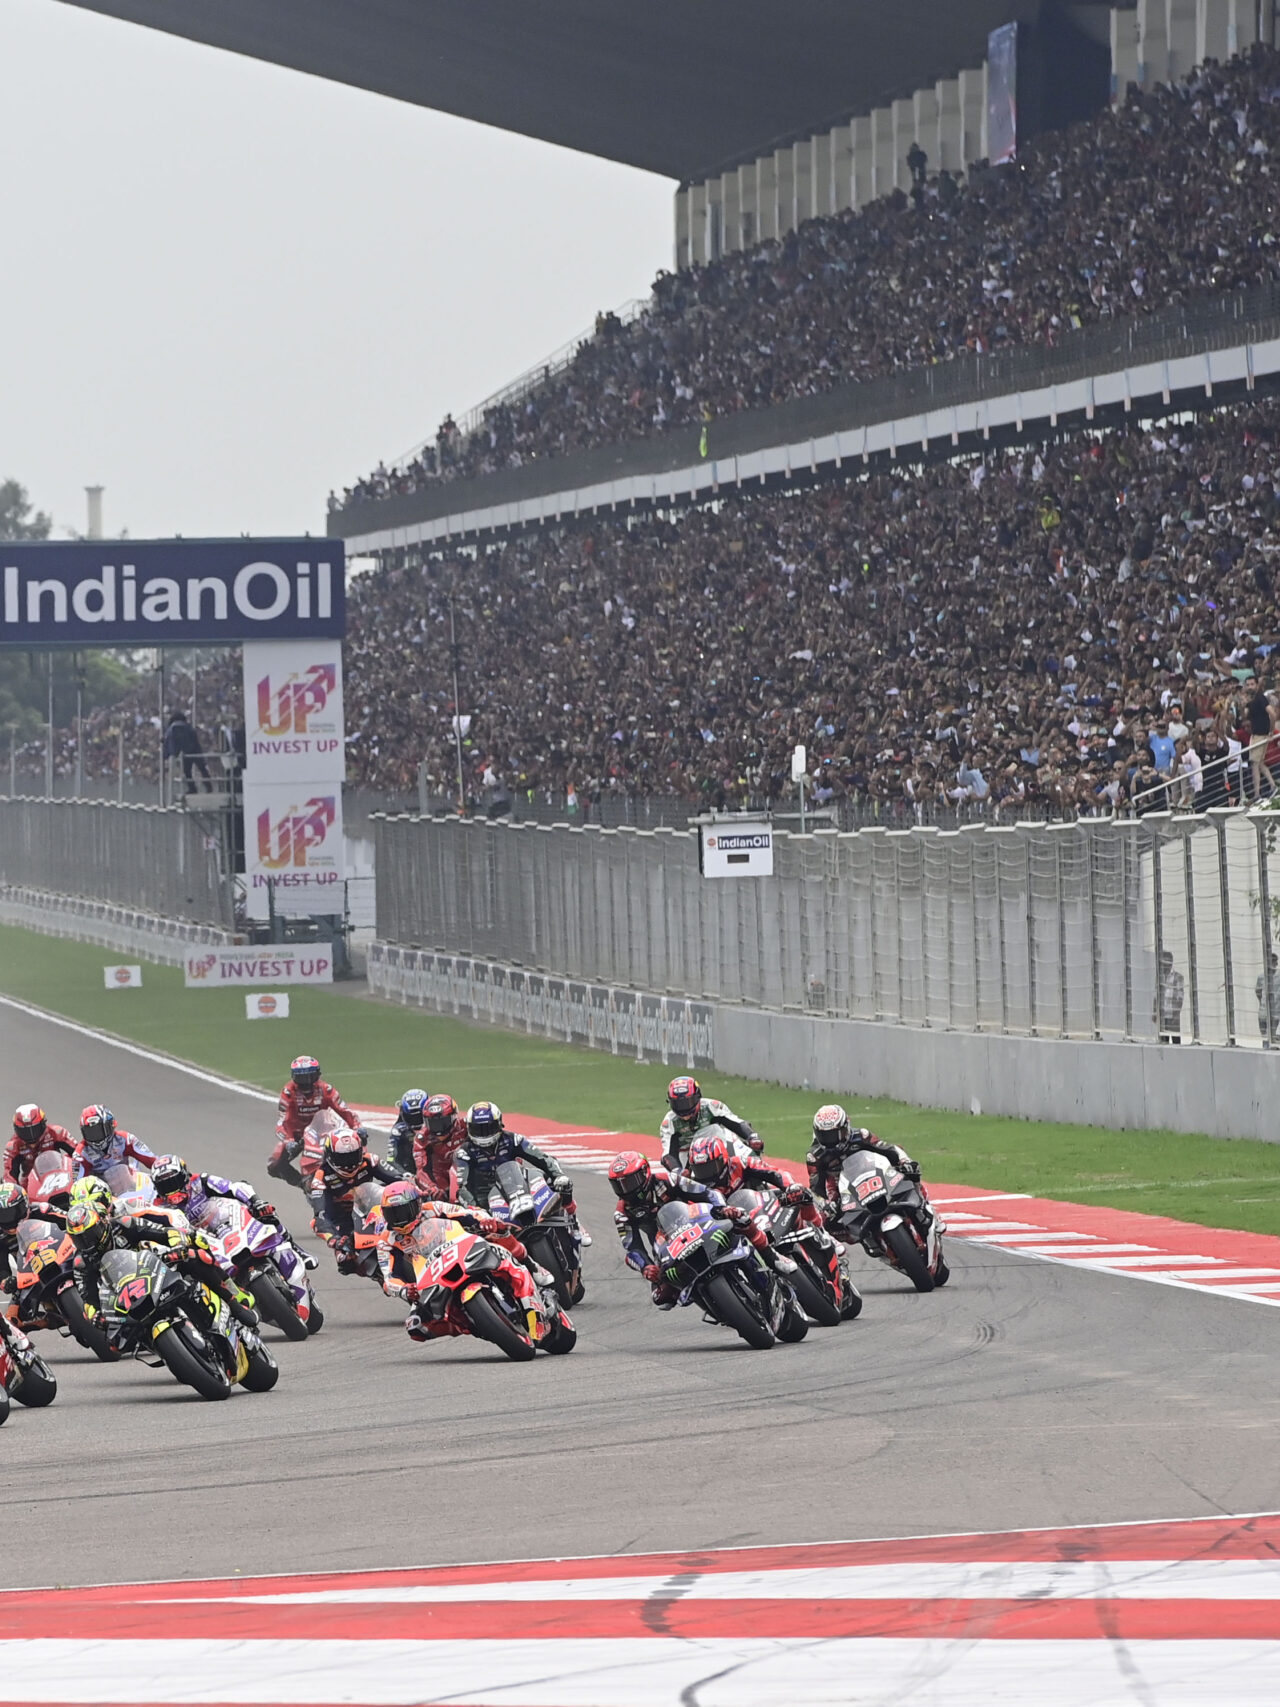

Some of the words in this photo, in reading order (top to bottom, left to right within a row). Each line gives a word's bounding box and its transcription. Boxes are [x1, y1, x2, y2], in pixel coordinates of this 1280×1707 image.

[4, 562, 332, 622] IndianOil
[252, 740, 311, 754] INVEST
[317, 739, 339, 754] UP
[719, 835, 769, 849] IndianOil
[252, 872, 310, 888] INVEST
[317, 871, 339, 886] UP
[221, 960, 296, 978] INVEST
[300, 959, 329, 977] UP
[856, 1175, 884, 1201] 30
[30, 1248, 57, 1275] 33
[430, 1243, 459, 1282] 93
[118, 1278, 147, 1311] 72
